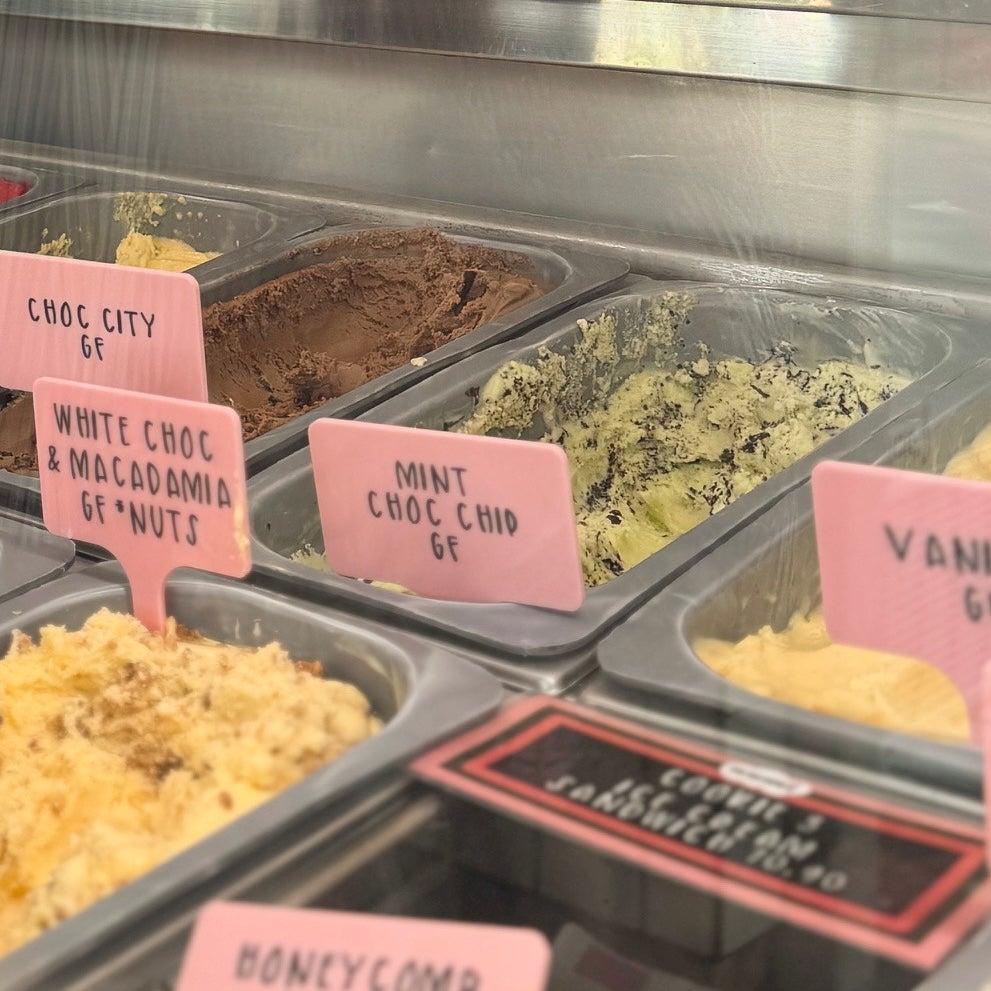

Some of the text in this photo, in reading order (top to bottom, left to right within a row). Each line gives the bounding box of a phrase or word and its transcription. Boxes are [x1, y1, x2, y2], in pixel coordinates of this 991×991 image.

[28, 298, 156, 339] CHOC CITY
[81, 334, 105, 362] GF
[53, 402, 214, 463] WHITE CHOC
[48, 445, 232, 509] & MACADAMIA
[395, 460, 468, 498] MINT
[81, 490, 106, 525] GF
[367, 491, 520, 538] CHOC CHIP
[430, 532, 460, 564] GF
[544, 774, 737, 853] SANDWICH
[609, 776, 676, 811] ICE
[684, 803, 819, 860] CREAM
[233, 941, 484, 991] HONEYCOMB
